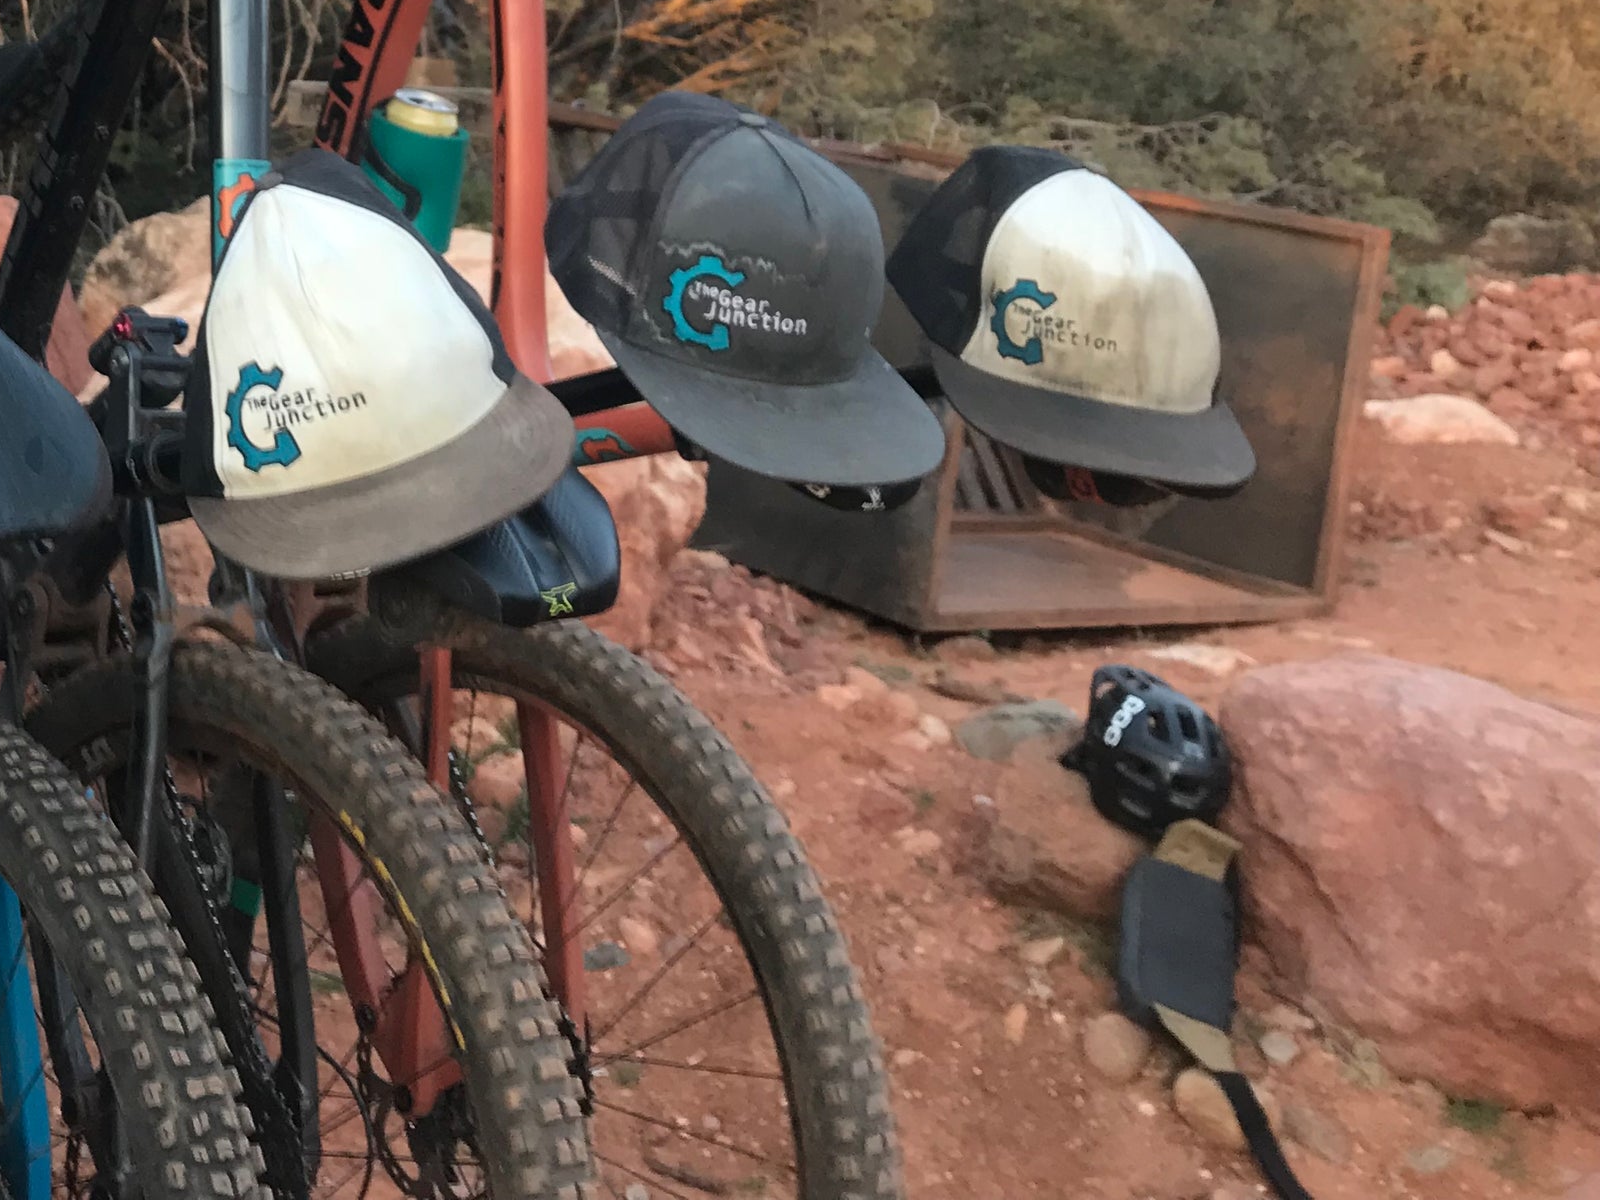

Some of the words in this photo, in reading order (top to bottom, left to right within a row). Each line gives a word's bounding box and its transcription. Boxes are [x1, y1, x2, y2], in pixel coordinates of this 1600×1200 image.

[719, 289, 771, 315] Gear
[704, 301, 808, 336] Junction
[1032, 310, 1076, 329] Gear
[1020, 320, 1118, 351] Junction
[264, 391, 368, 431] Junction
[268, 387, 316, 412] Gear
